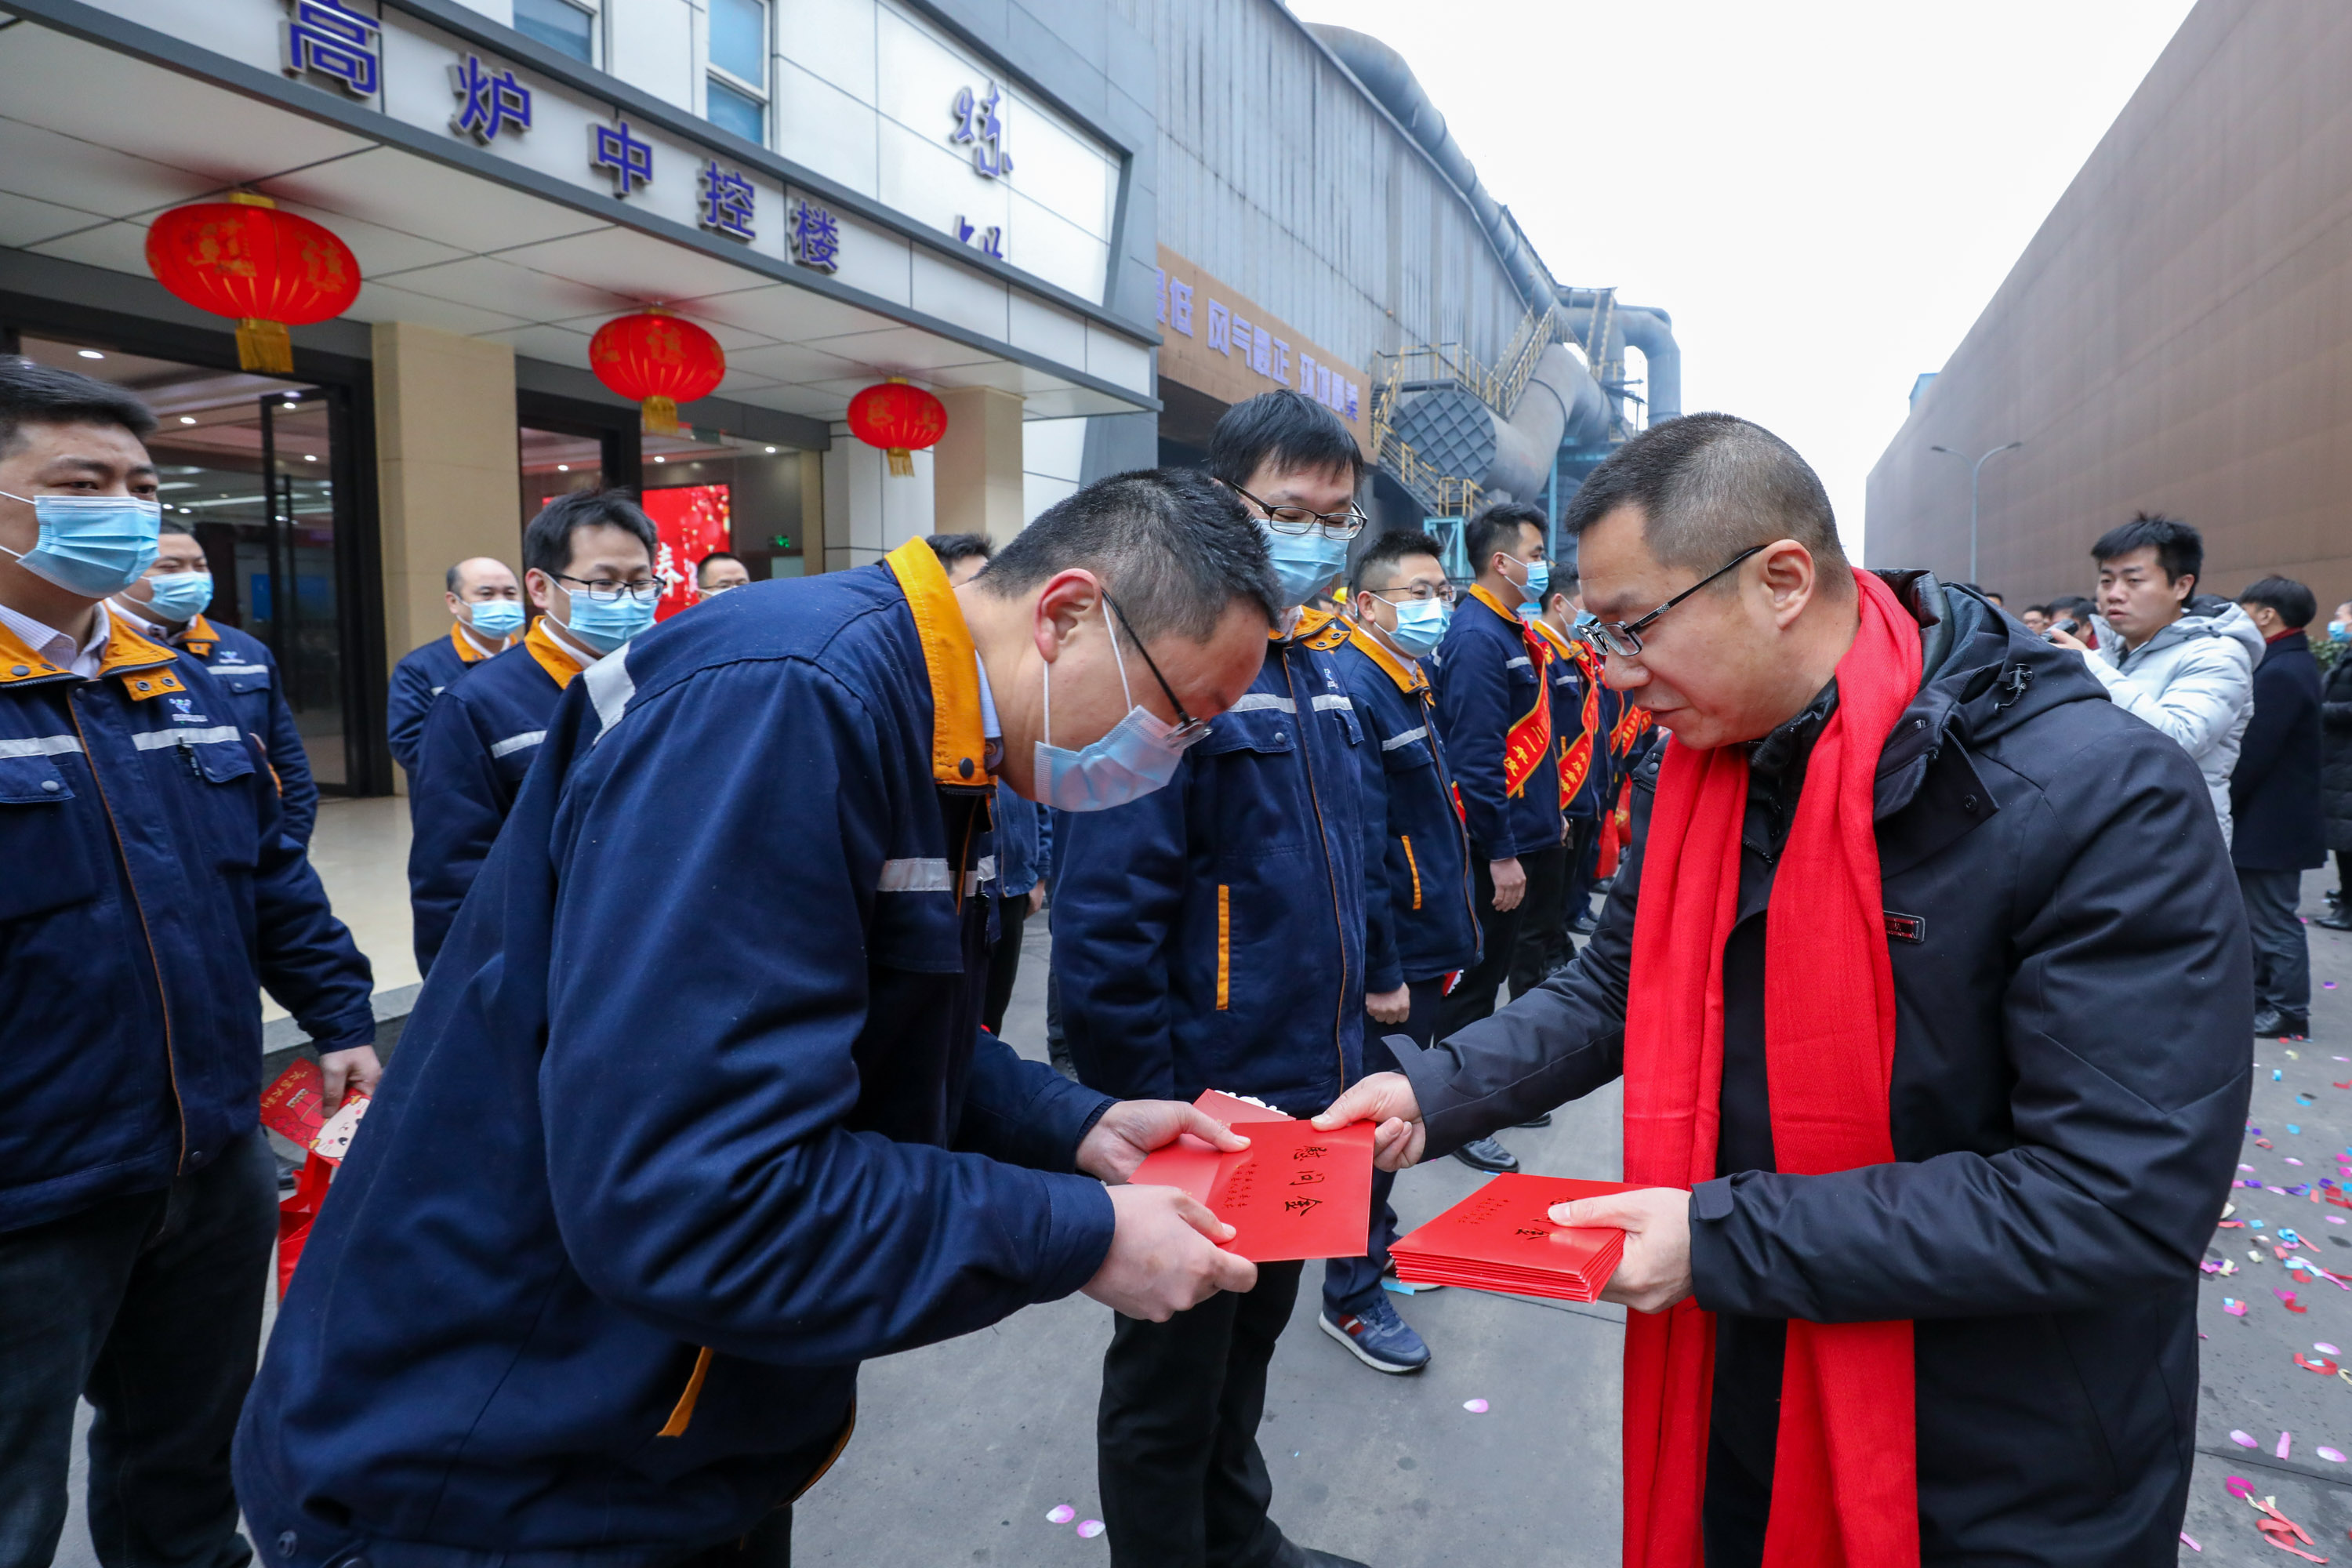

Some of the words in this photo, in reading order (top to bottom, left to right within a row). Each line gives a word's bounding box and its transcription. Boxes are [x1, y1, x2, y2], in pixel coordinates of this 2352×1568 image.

[283, 0, 839, 272] 高炉中控楼
[1207, 298, 1290, 387] 风气最正
[1284, 1145, 1327, 1217] 慰问金
